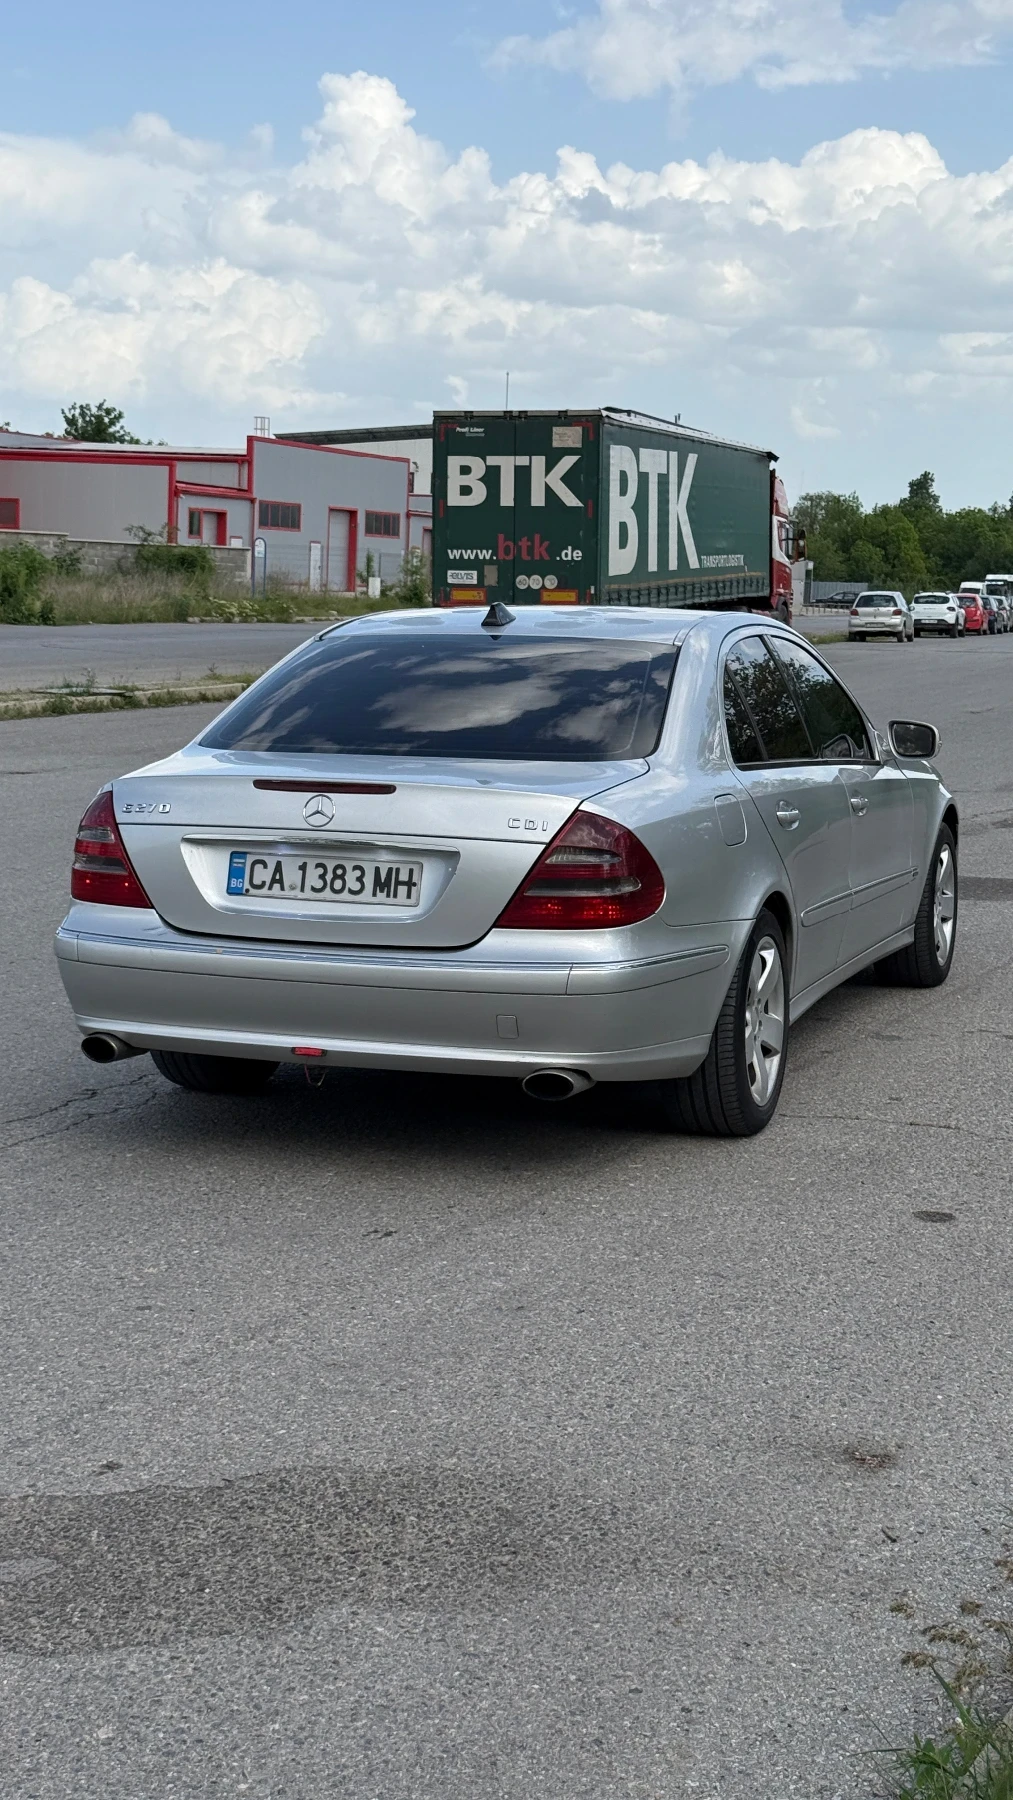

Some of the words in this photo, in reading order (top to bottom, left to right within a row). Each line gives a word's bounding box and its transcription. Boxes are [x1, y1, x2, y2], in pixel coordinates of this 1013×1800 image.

[447, 455, 585, 507] BTK
[608, 444, 701, 576] BTK
[121, 803, 171, 814] E270
[508, 817, 548, 831] CDI
[230, 878, 243, 888] BG
[249, 859, 286, 892] CA
[298, 861, 366, 896] 1383
[372, 865, 415, 899] MH
